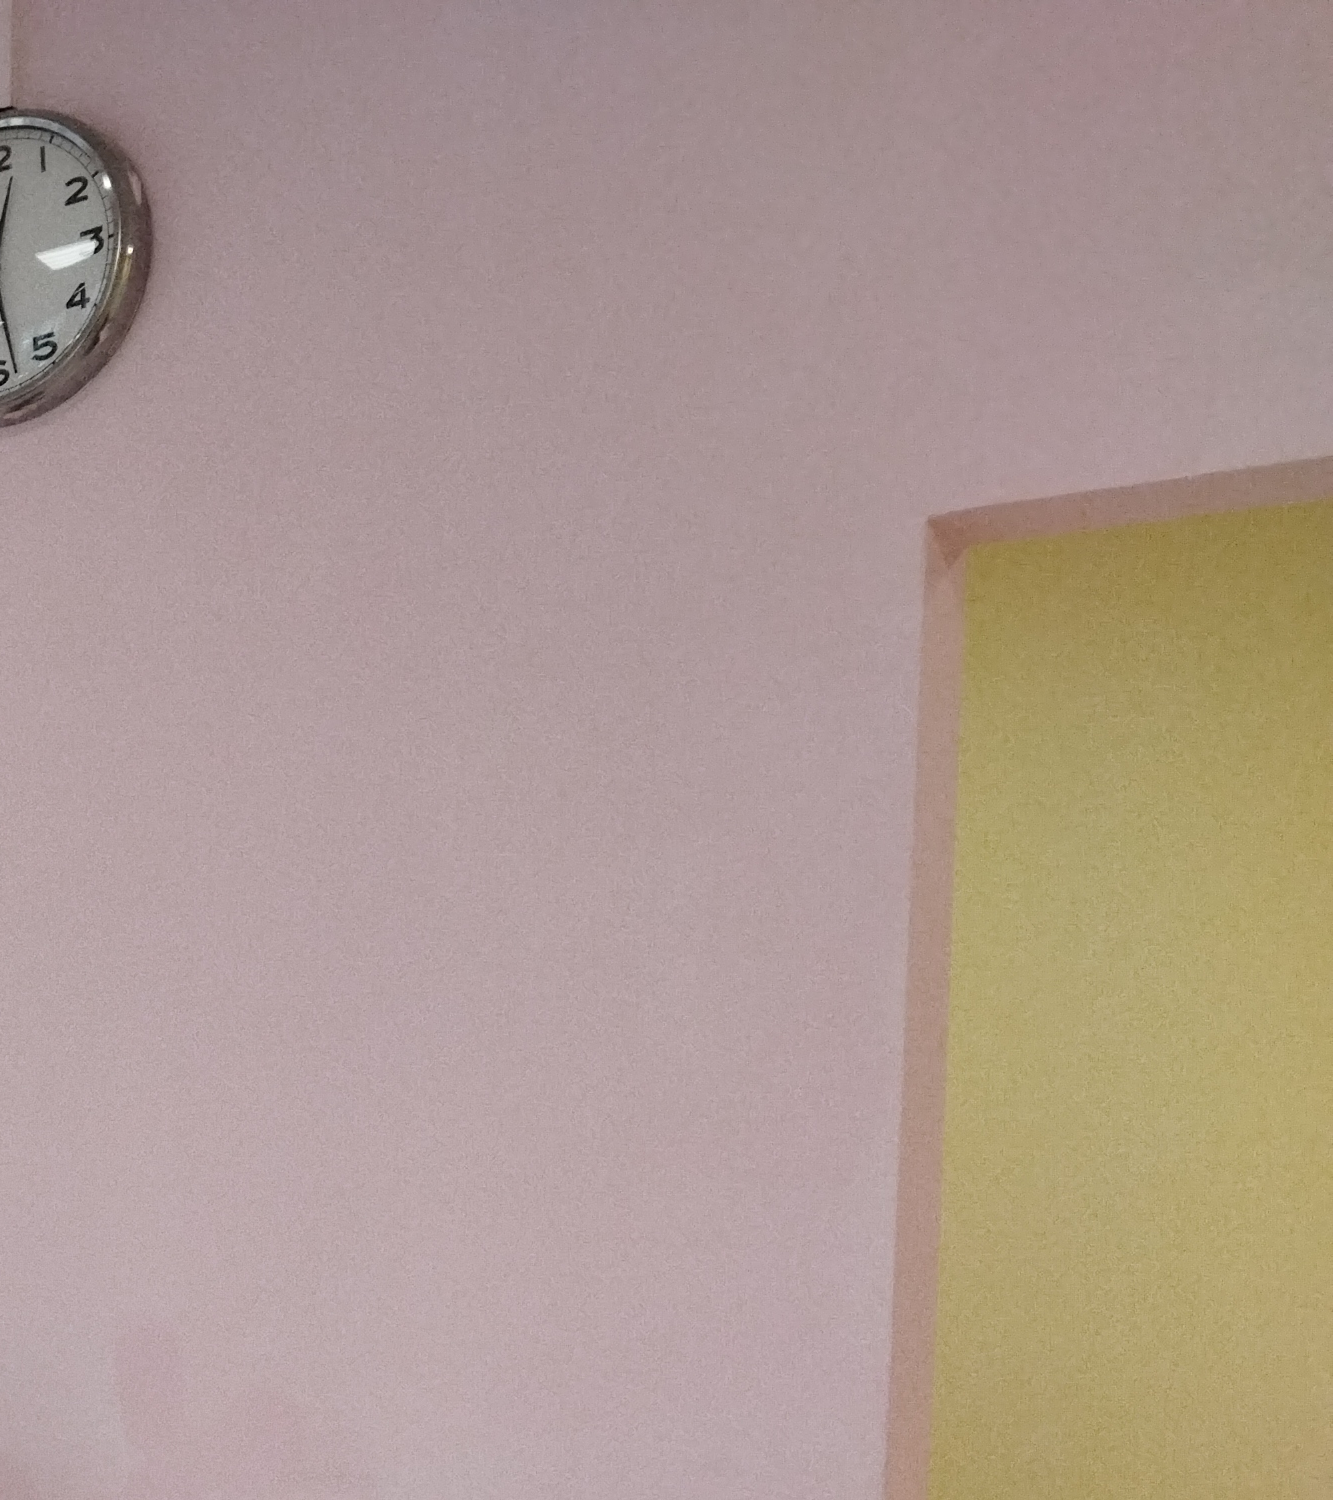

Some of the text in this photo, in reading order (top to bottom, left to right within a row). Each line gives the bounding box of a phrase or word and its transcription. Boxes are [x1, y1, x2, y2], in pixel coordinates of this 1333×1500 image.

[40, 146, 46, 172] 1
[64, 176, 88, 206] 2
[80, 225, 104, 254] 3
[66, 282, 90, 309] 4
[31, 332, 58, 361] 5
